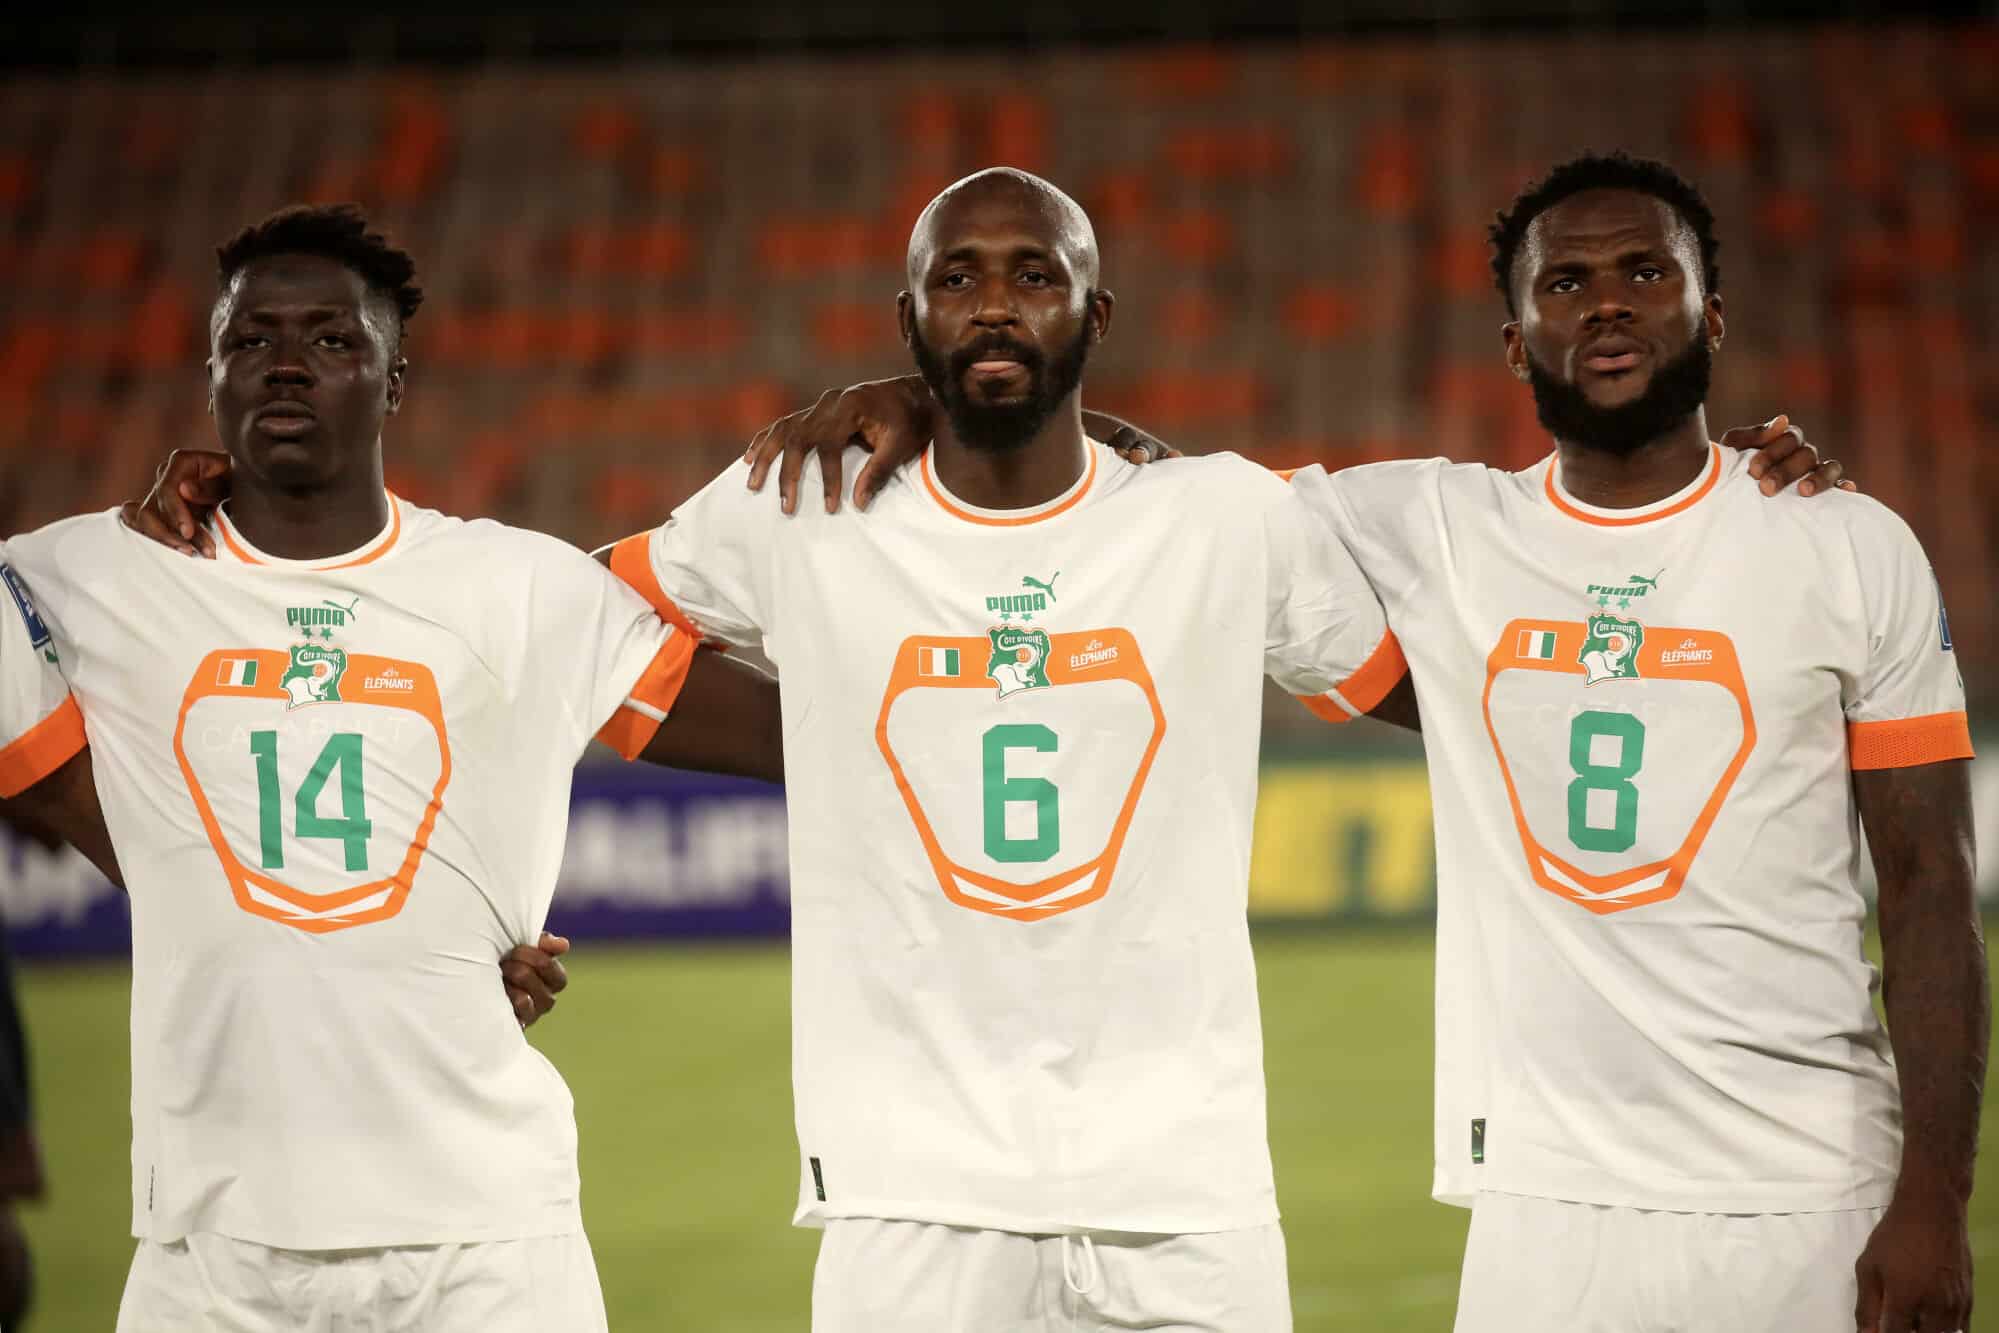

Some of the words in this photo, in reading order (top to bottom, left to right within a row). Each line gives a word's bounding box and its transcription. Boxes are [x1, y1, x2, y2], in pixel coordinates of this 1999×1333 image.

[286, 607, 345, 627] PUMA
[985, 592, 1047, 613] PUMA
[1586, 584, 1648, 597] PUMA
[250, 730, 372, 871] 14
[982, 724, 1060, 863] 6
[1568, 710, 1646, 853] 8
